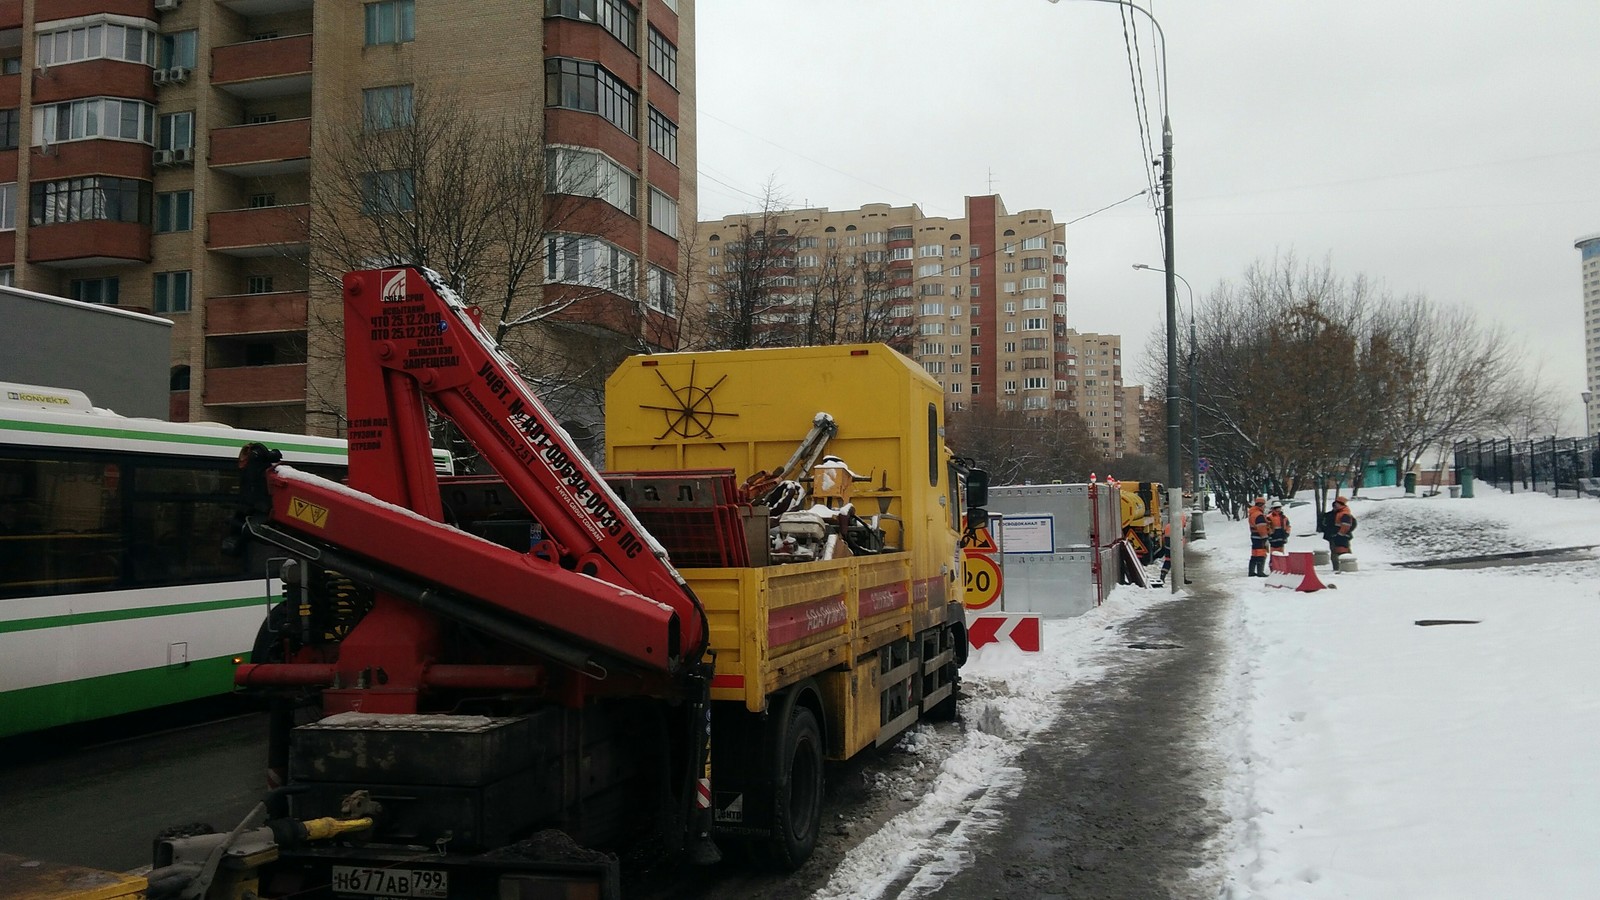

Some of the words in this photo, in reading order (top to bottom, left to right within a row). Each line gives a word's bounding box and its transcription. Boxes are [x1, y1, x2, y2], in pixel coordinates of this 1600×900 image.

[371, 315, 389, 327] ЧТО
[371, 329, 389, 341] ПТО
[417, 338, 444, 347] РАБОТА
[402, 356, 460, 369] ЗАПРЕЩЕНА!
[19, 393, 70, 405] KONVEKTA
[558, 490, 571, 505] HYVA
[569, 502, 585, 520] GROUP
[582, 517, 604, 543] COMPANY
[414, 871, 443, 889] 799
